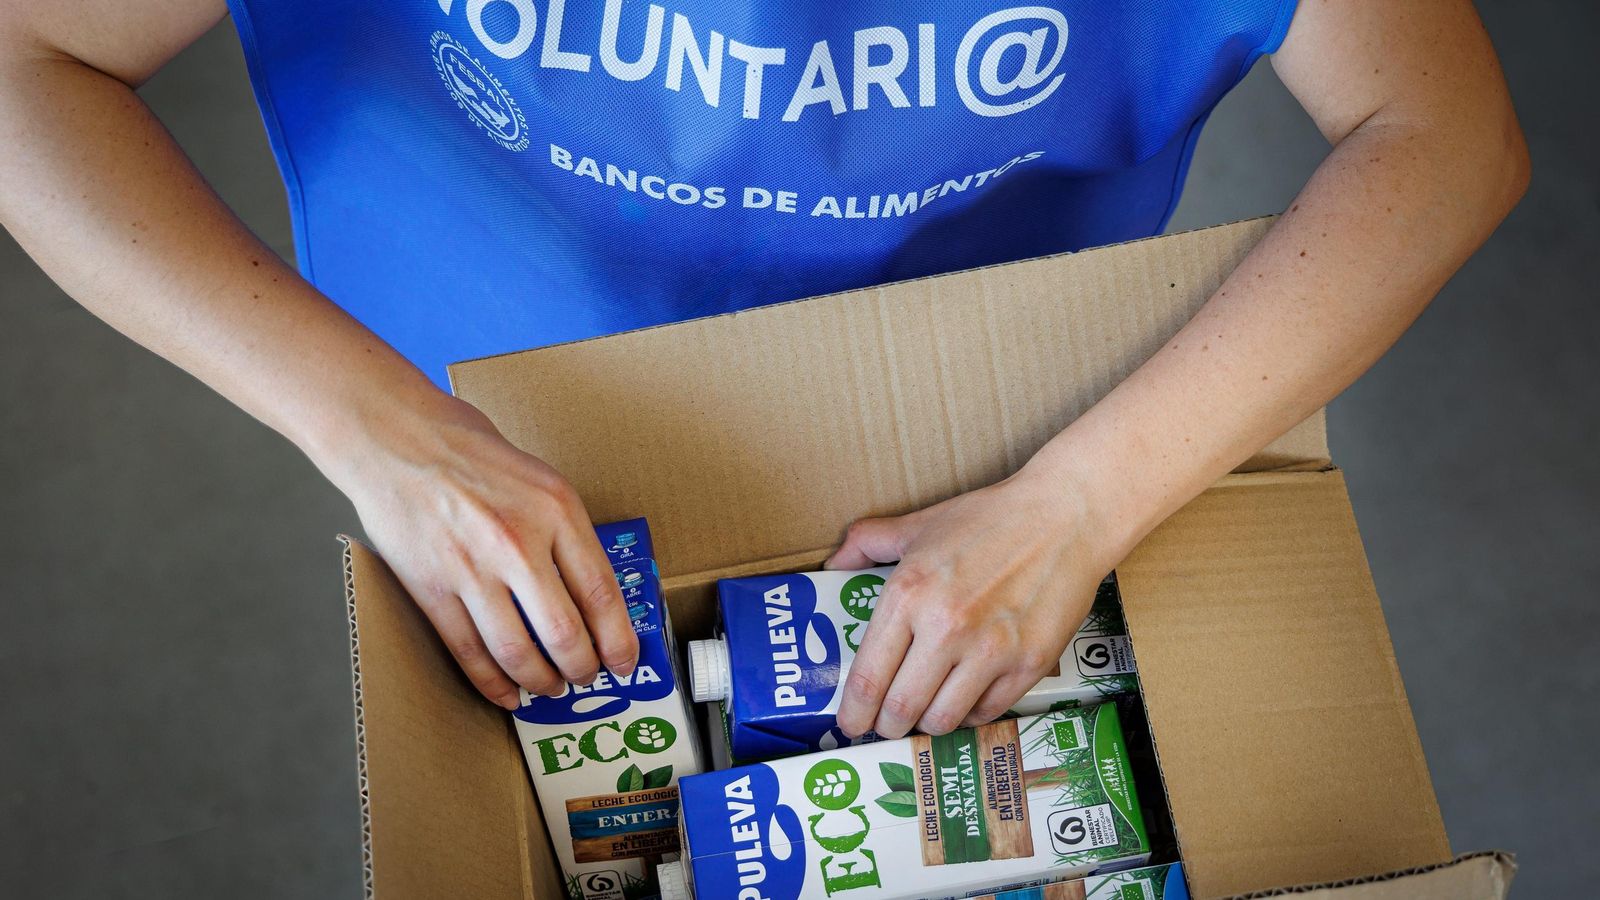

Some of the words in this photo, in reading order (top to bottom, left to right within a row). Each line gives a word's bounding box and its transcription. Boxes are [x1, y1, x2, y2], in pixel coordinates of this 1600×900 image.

[438, 0, 1068, 121] OLUNTARI@
[449, 52, 505, 110] FESBAL
[550, 143, 727, 209] BANCOS
[743, 187, 798, 214] DE
[810, 151, 1046, 219] ALIMENTOS
[763, 583, 807, 707] PULEVA
[532, 716, 678, 775] ECO
[1007, 743, 1020, 781] NATURALES
[919, 750, 936, 807] ECOLÓGICA
[941, 766, 963, 818] SEMI
[958, 743, 980, 837] DESNATADA
[984, 760, 997, 810] ALIMENTACIÓN
[992, 746, 1012, 803] LIBERTAD
[592, 796, 625, 808] LECHE
[924, 809, 939, 841] LECHE
[1000, 806, 1013, 821] EN
[1014, 807, 1024, 821] CON
[1085, 809, 1098, 846] BIENESTAR
[1098, 807, 1110, 844] CERTIFICADO
[612, 842, 628, 851] EN
[803, 758, 882, 898] ECO
[1094, 818, 1104, 845] ANIMAL
